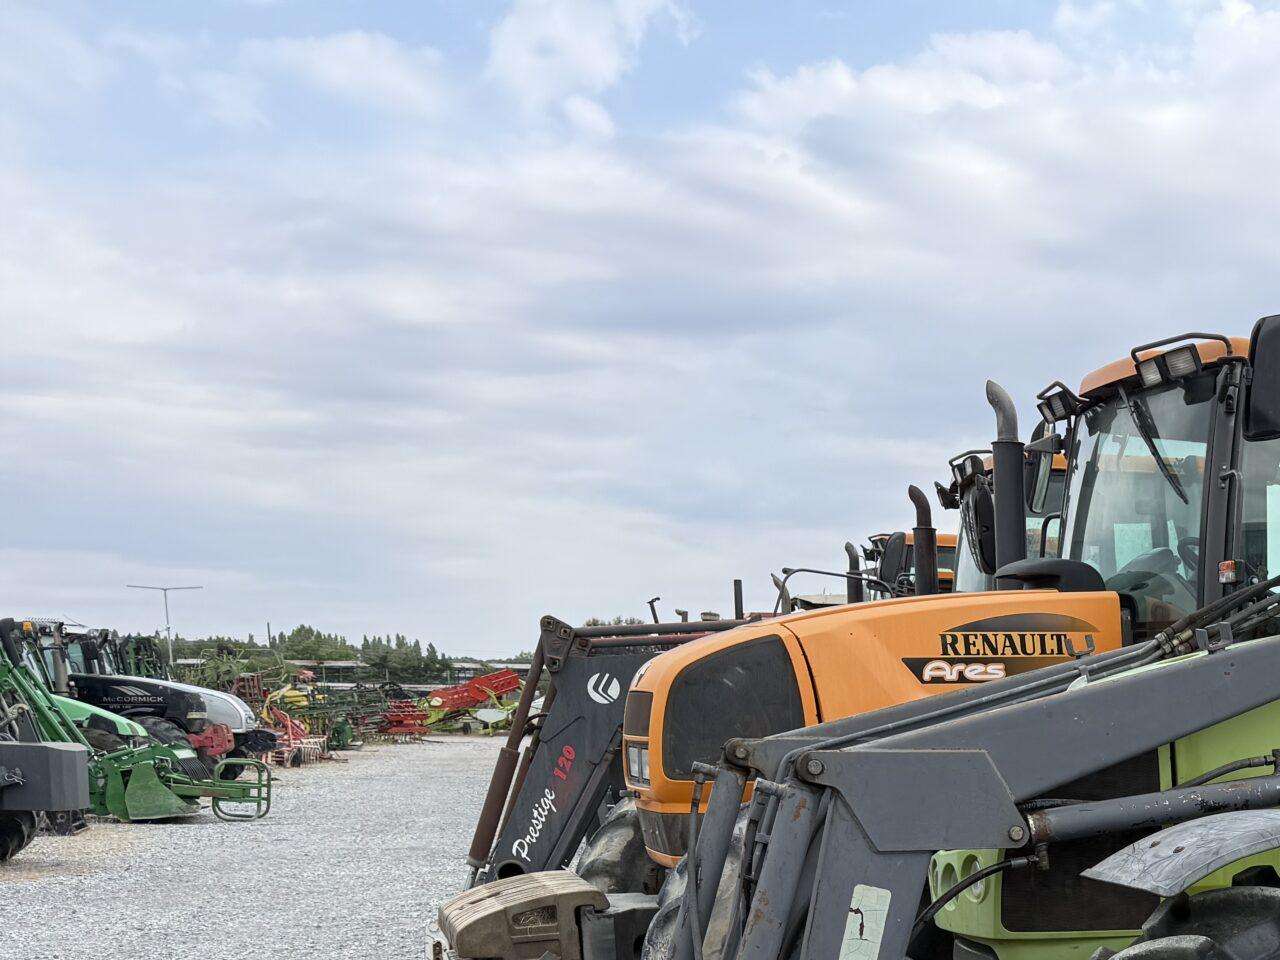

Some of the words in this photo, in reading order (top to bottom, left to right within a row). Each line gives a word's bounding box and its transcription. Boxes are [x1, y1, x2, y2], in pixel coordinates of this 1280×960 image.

[939, 633, 1067, 656] RENAULT
[922, 660, 1006, 682] Ares
[553, 744, 577, 781] 120
